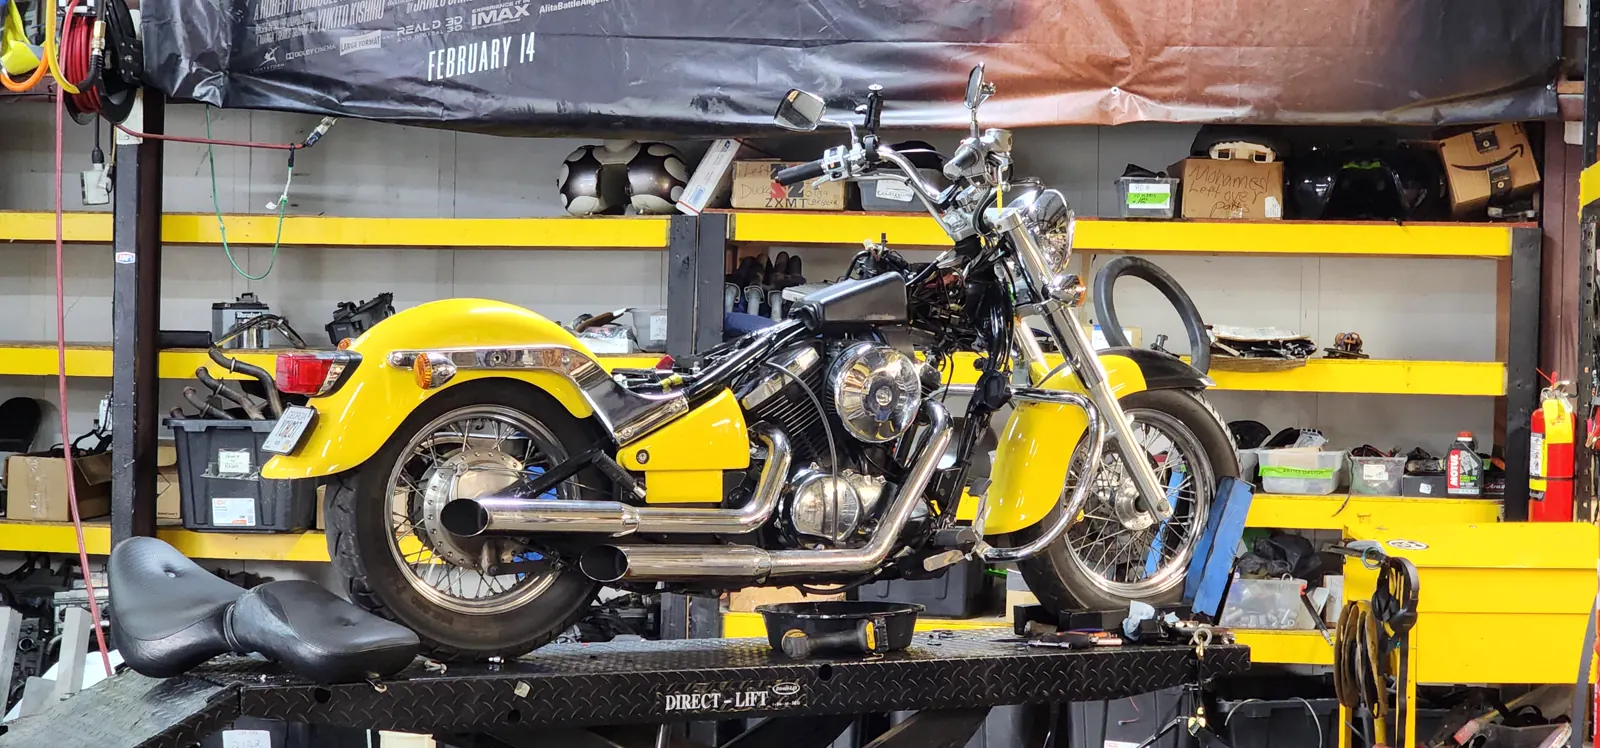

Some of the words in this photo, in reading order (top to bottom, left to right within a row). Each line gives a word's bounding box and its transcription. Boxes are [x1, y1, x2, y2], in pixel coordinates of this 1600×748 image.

[317, 4, 349, 32] YUKITO
[350, 0, 385, 25] KISHIRO
[471, 4, 530, 27] IMAX
[472, 1, 514, 13] EXPERIENCE
[341, 40, 359, 52] LARGE
[359, 35, 381, 48] FORMAT
[414, 30, 444, 39] DIGITAL
[295, 48, 313, 58] DOLBY
[313, 44, 337, 54] CINEMA
[427, 35, 512, 82] FEBRUARY
[519, 31, 536, 64] 14
[1188, 164, 1271, 193] Mohamed
[765, 198, 808, 208] ZXMT
[1189, 180, 1221, 198] Left
[1223, 190, 1264, 205] over
[1450, 453, 1459, 487] MOTUL
[665, 692, 721, 711] DIRECT
[735, 690, 769, 708] LIFT
